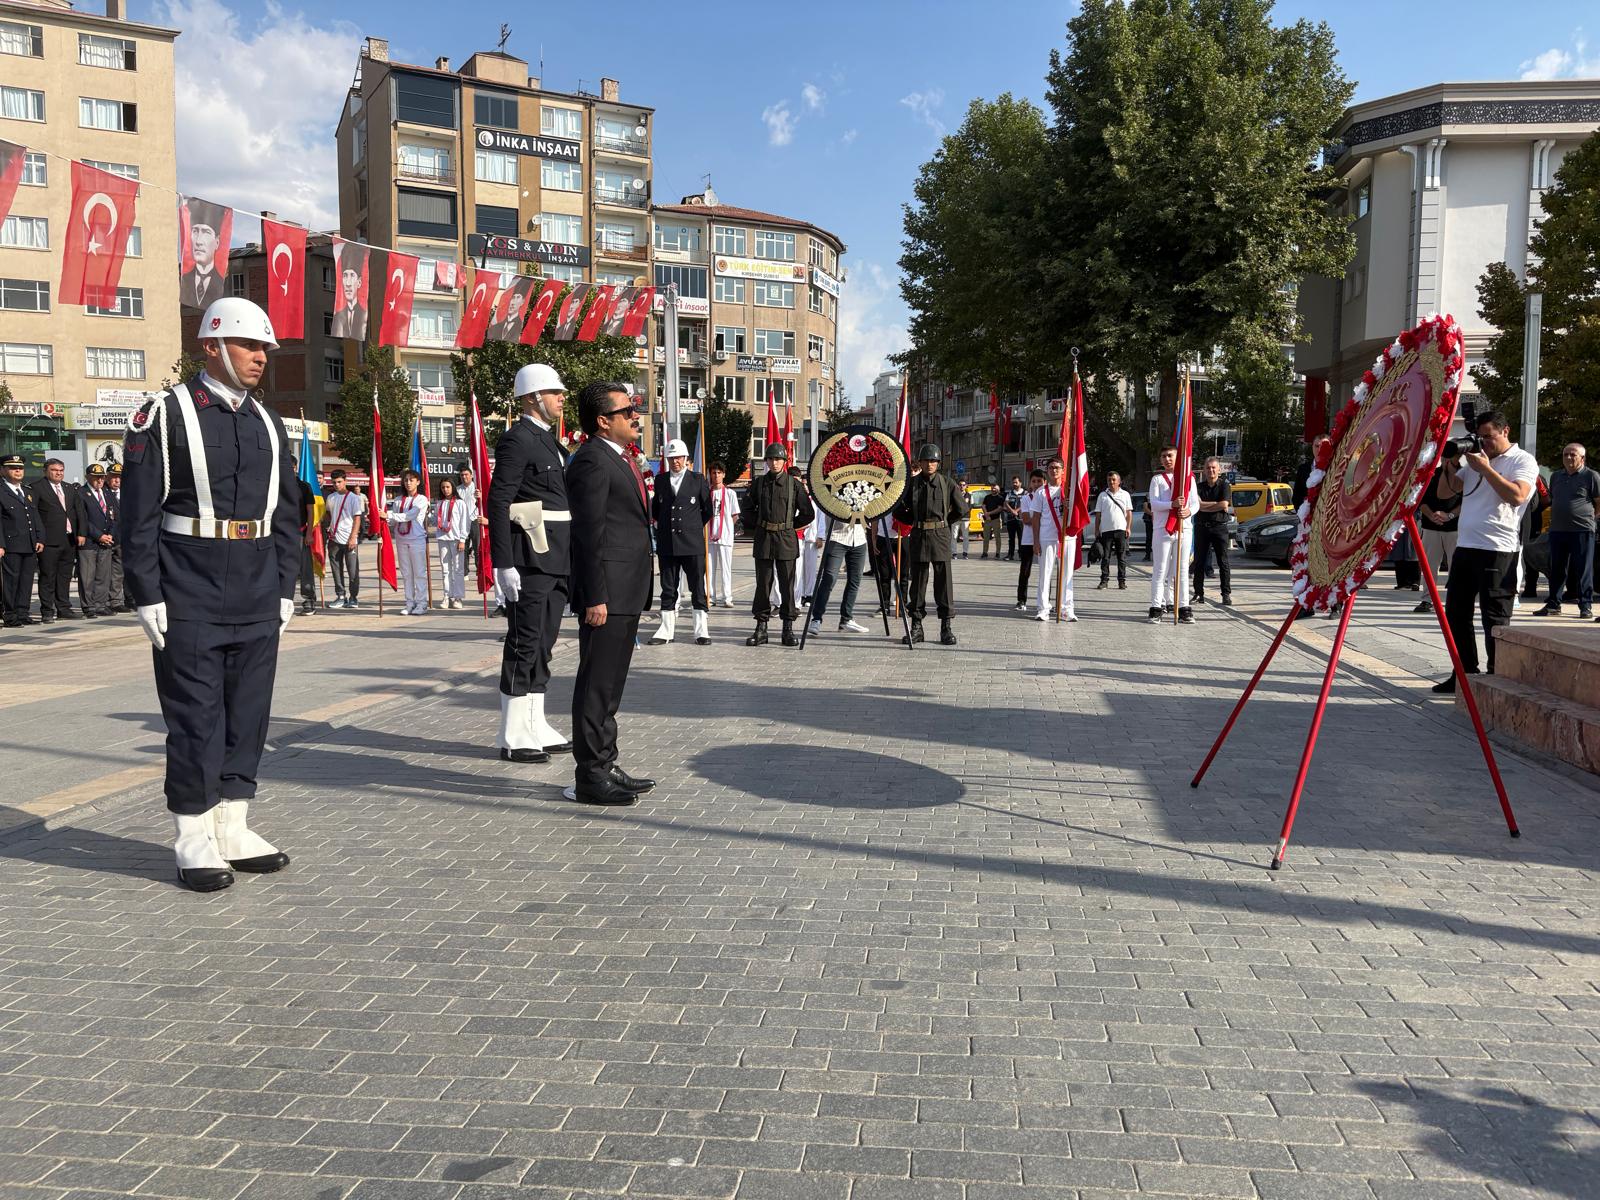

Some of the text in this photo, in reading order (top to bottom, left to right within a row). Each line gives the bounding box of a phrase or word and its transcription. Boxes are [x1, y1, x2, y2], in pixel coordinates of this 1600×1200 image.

[496, 132, 579, 157] İNKA İNŞAAT
[523, 242, 532, 251] &
[537, 243, 578, 256] AYDIN
[548, 254, 579, 264] İNŞAAT
[739, 358, 764, 366] AVUKA
[441, 444, 470, 455] ajans
